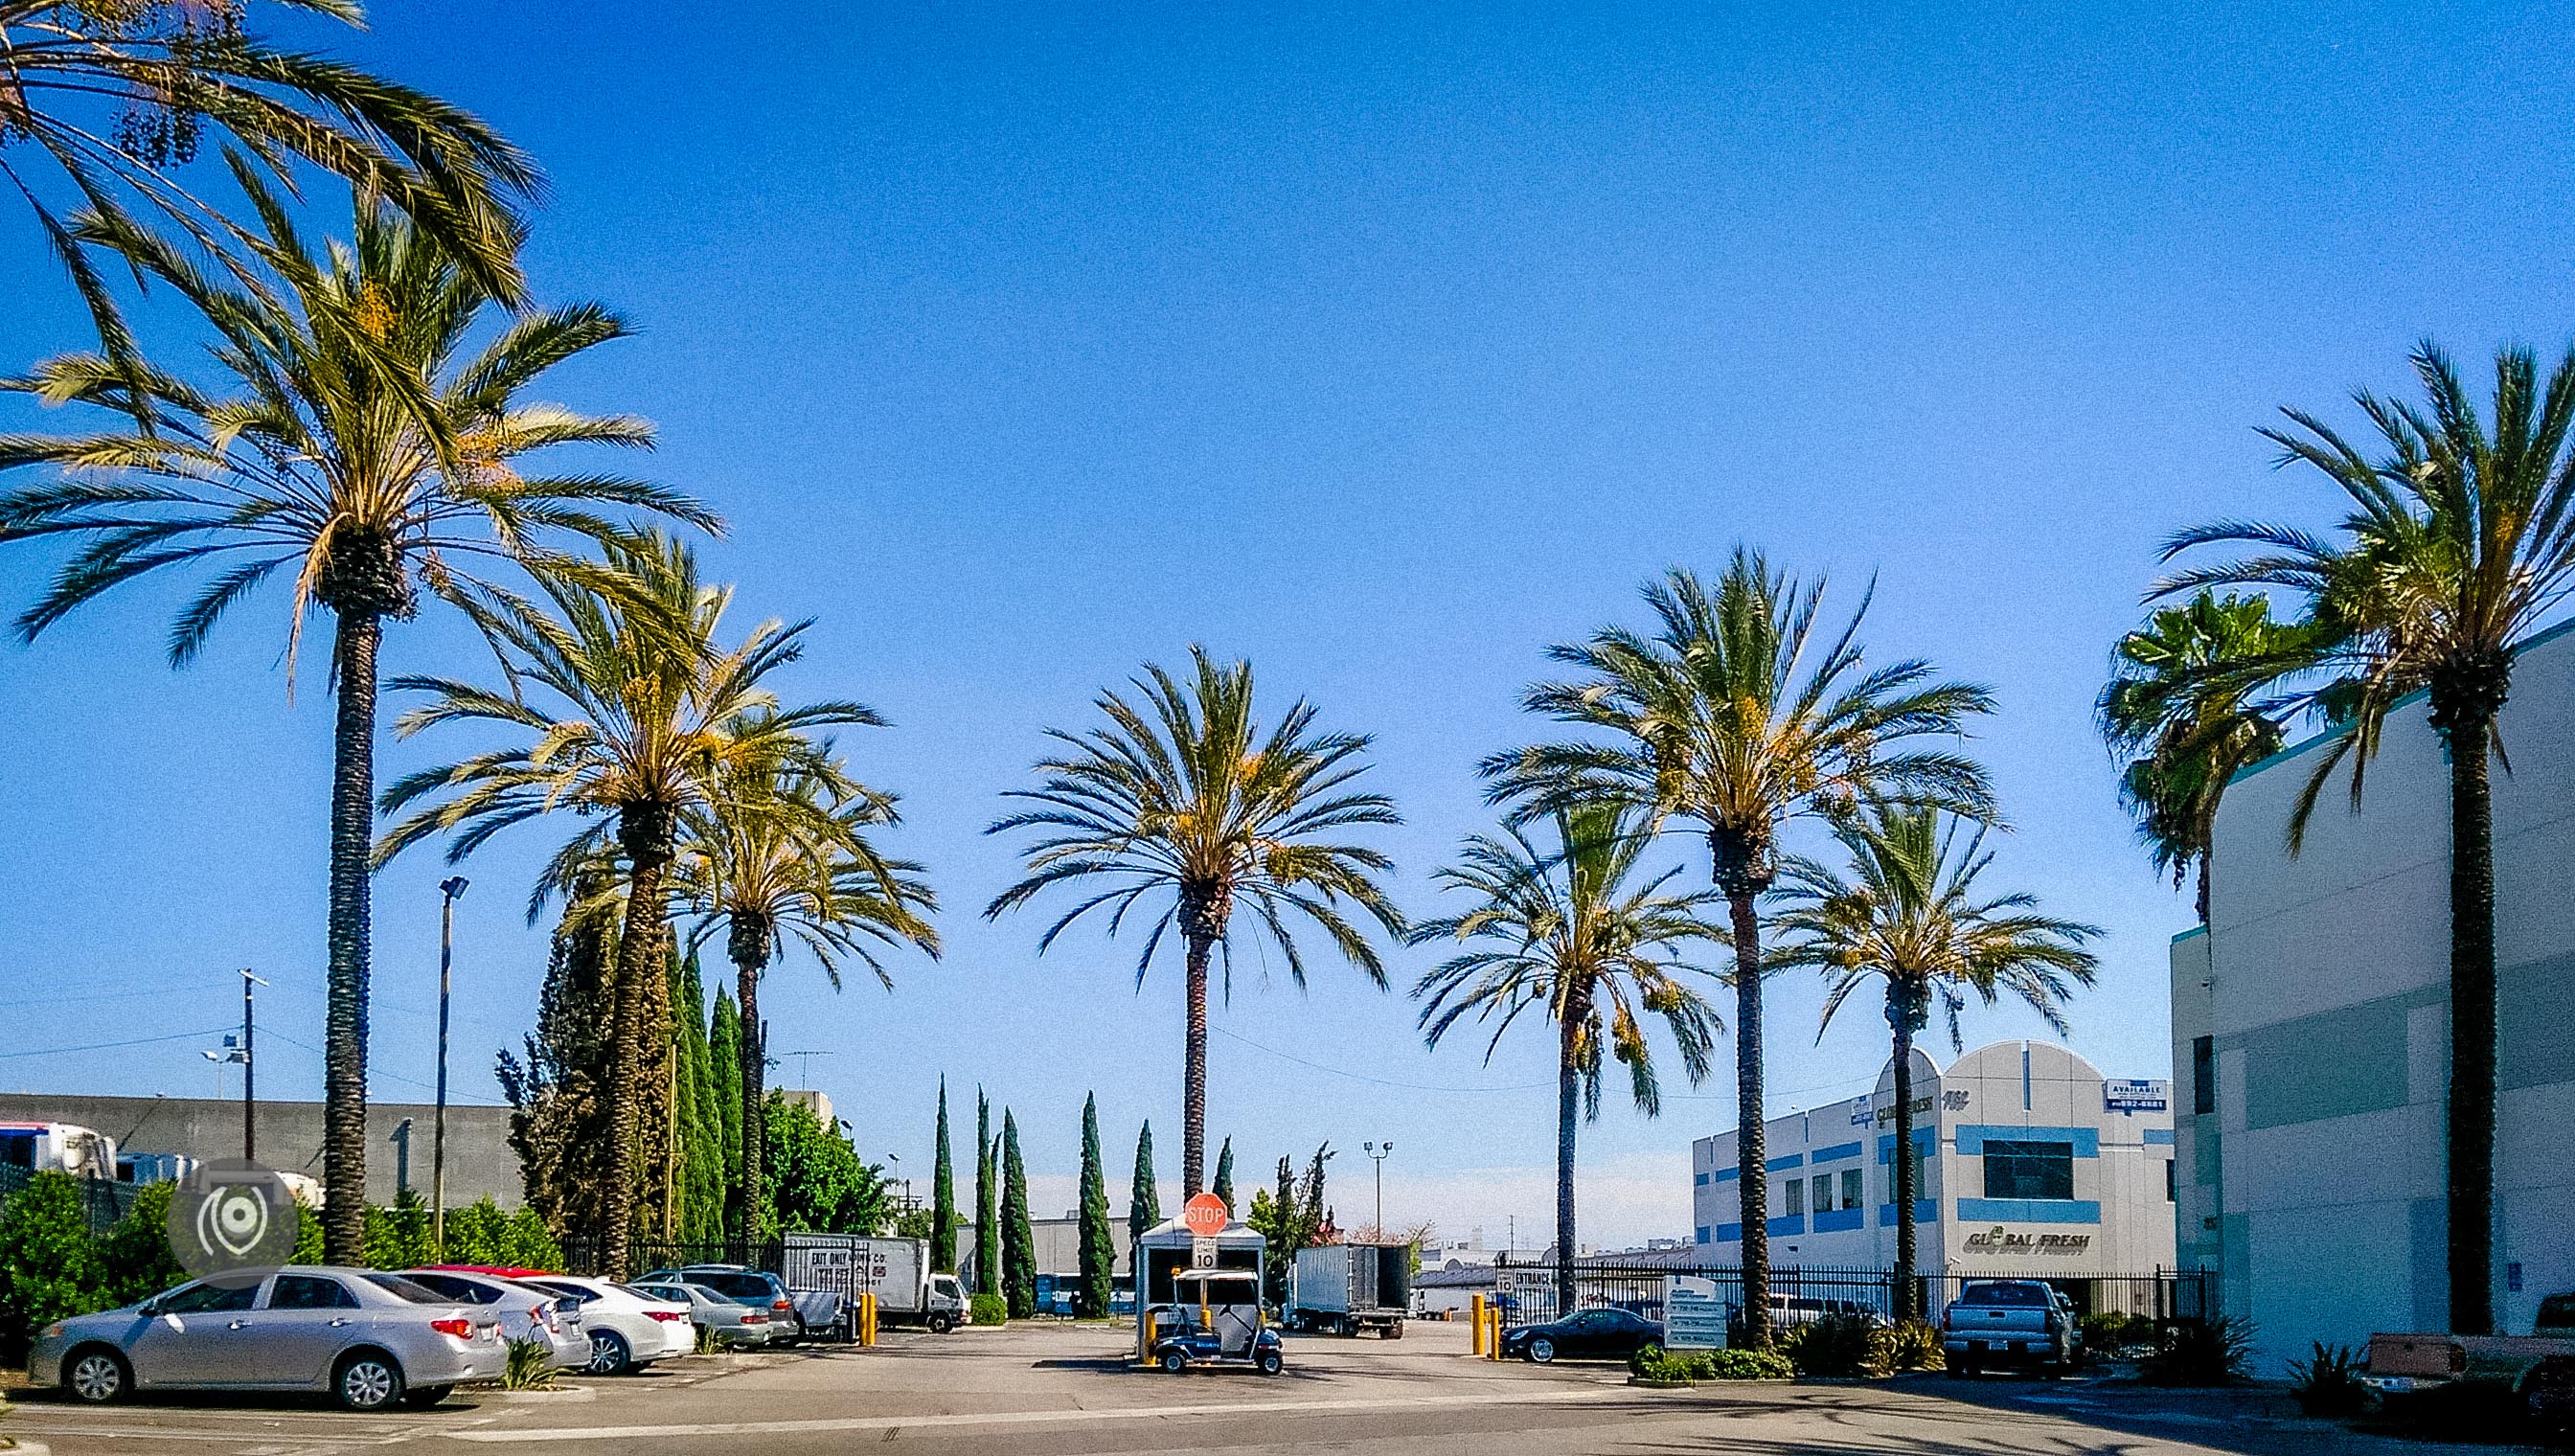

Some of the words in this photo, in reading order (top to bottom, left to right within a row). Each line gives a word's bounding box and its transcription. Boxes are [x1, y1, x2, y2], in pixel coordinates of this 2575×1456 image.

[2113, 1085, 2160, 1094] AVAILABLE
[1189, 1206, 1224, 1223] STOP
[2039, 1233, 2091, 1247] FRESH
[811, 1252, 827, 1265] EXIT
[829, 1252, 848, 1265] ONLY
[873, 1253, 888, 1263] CO.
[1197, 1255, 1214, 1267] 10
[1515, 1271, 1550, 1285] ENTRANCE
[1498, 1281, 1512, 1291] 10
